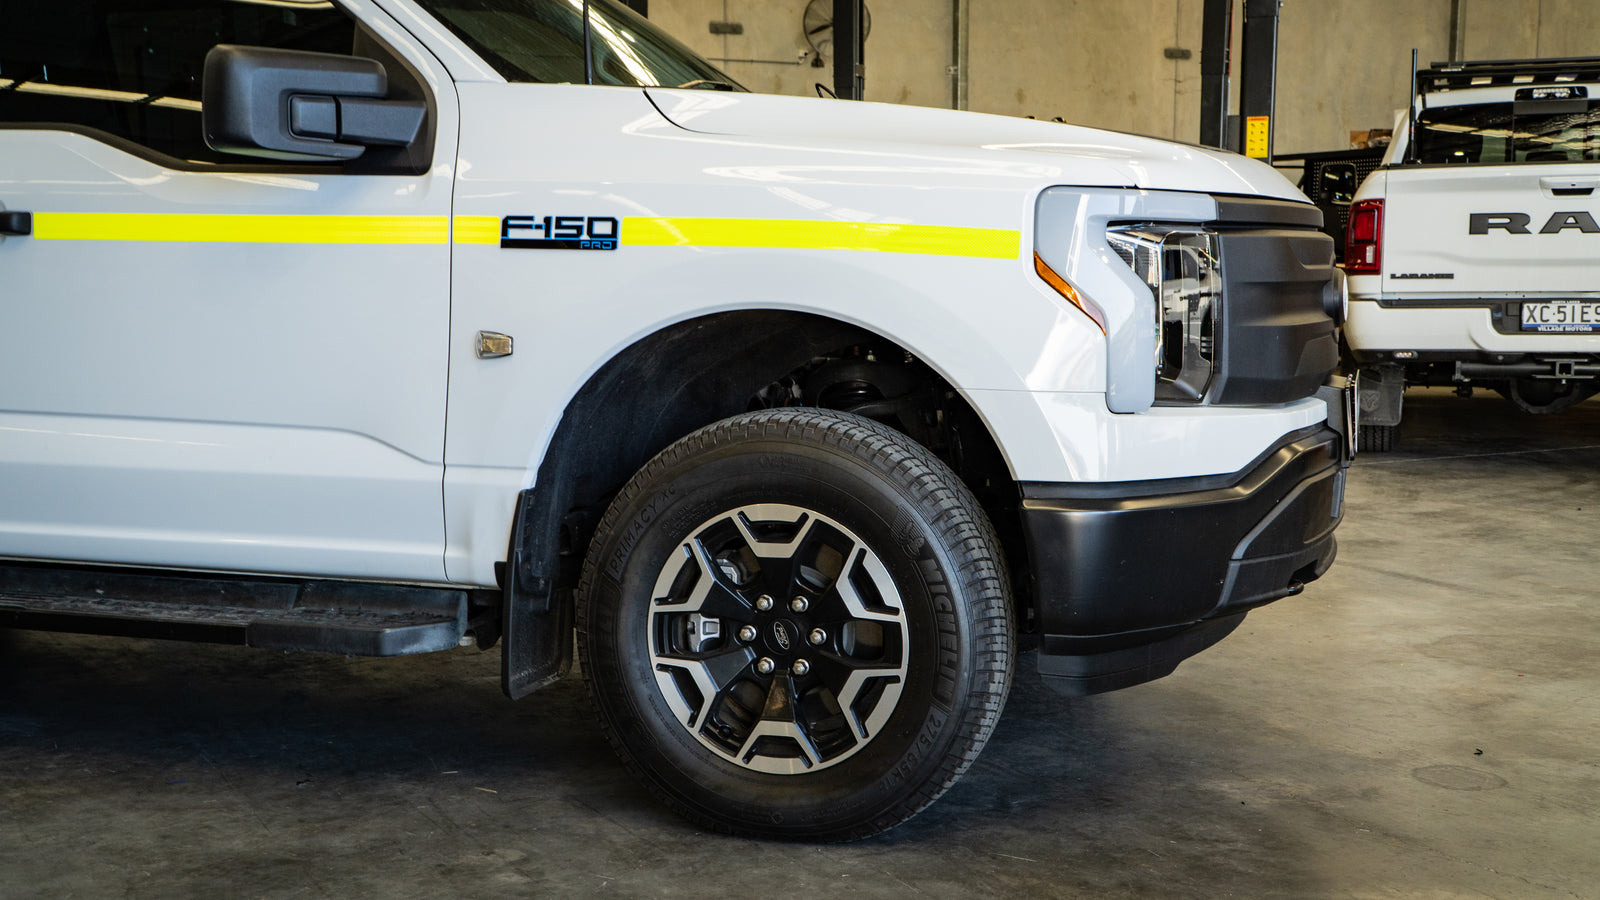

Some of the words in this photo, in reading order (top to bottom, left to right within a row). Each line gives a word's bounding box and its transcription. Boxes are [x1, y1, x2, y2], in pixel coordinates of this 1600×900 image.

[501, 215, 619, 240] F-150
[1469, 211, 1600, 234] RA
[580, 241, 612, 249] PRO
[610, 499, 658, 574] PRIMACY
[917, 558, 959, 700] MICHELIN
